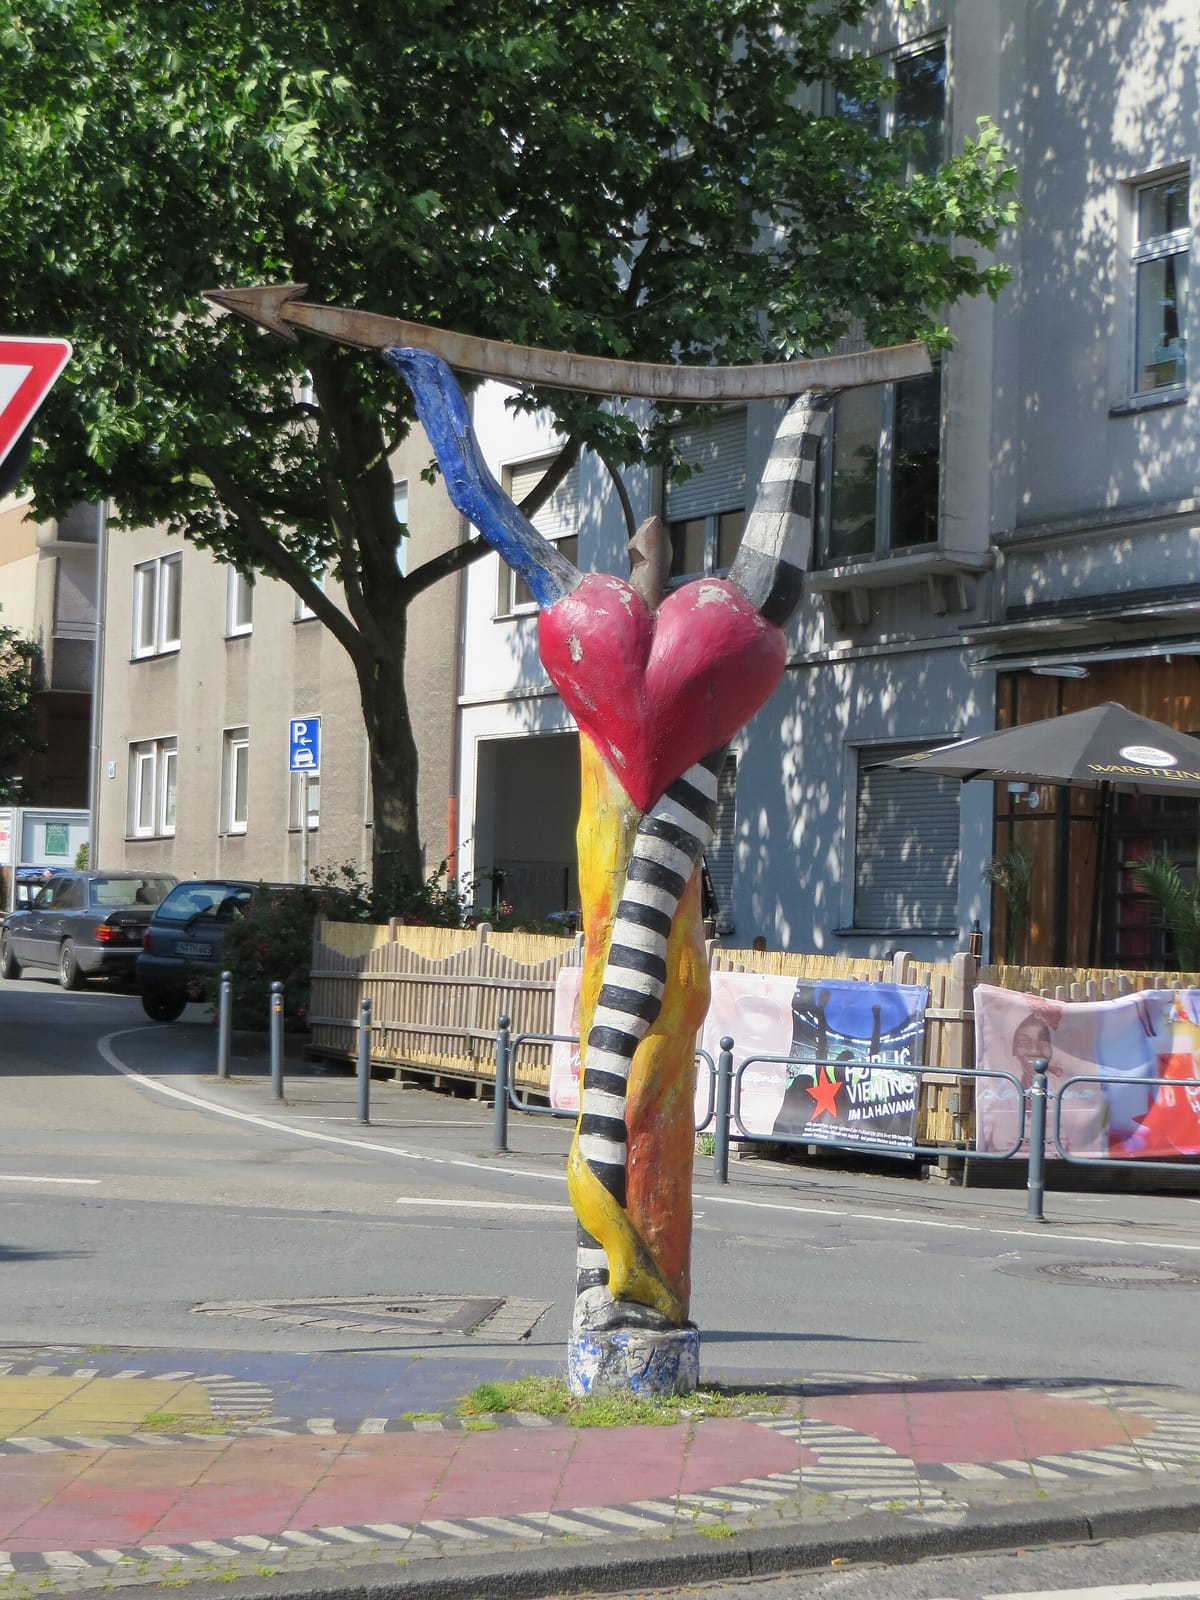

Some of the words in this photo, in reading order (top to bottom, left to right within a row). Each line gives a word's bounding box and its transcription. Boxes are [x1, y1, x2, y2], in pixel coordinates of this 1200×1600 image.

[294, 723, 308, 743] P
[846, 1073, 915, 1104] VIEWING
[848, 1108, 861, 1121] IM
[862, 1106, 874, 1119] LA
[874, 1098, 915, 1117] HAVANA
